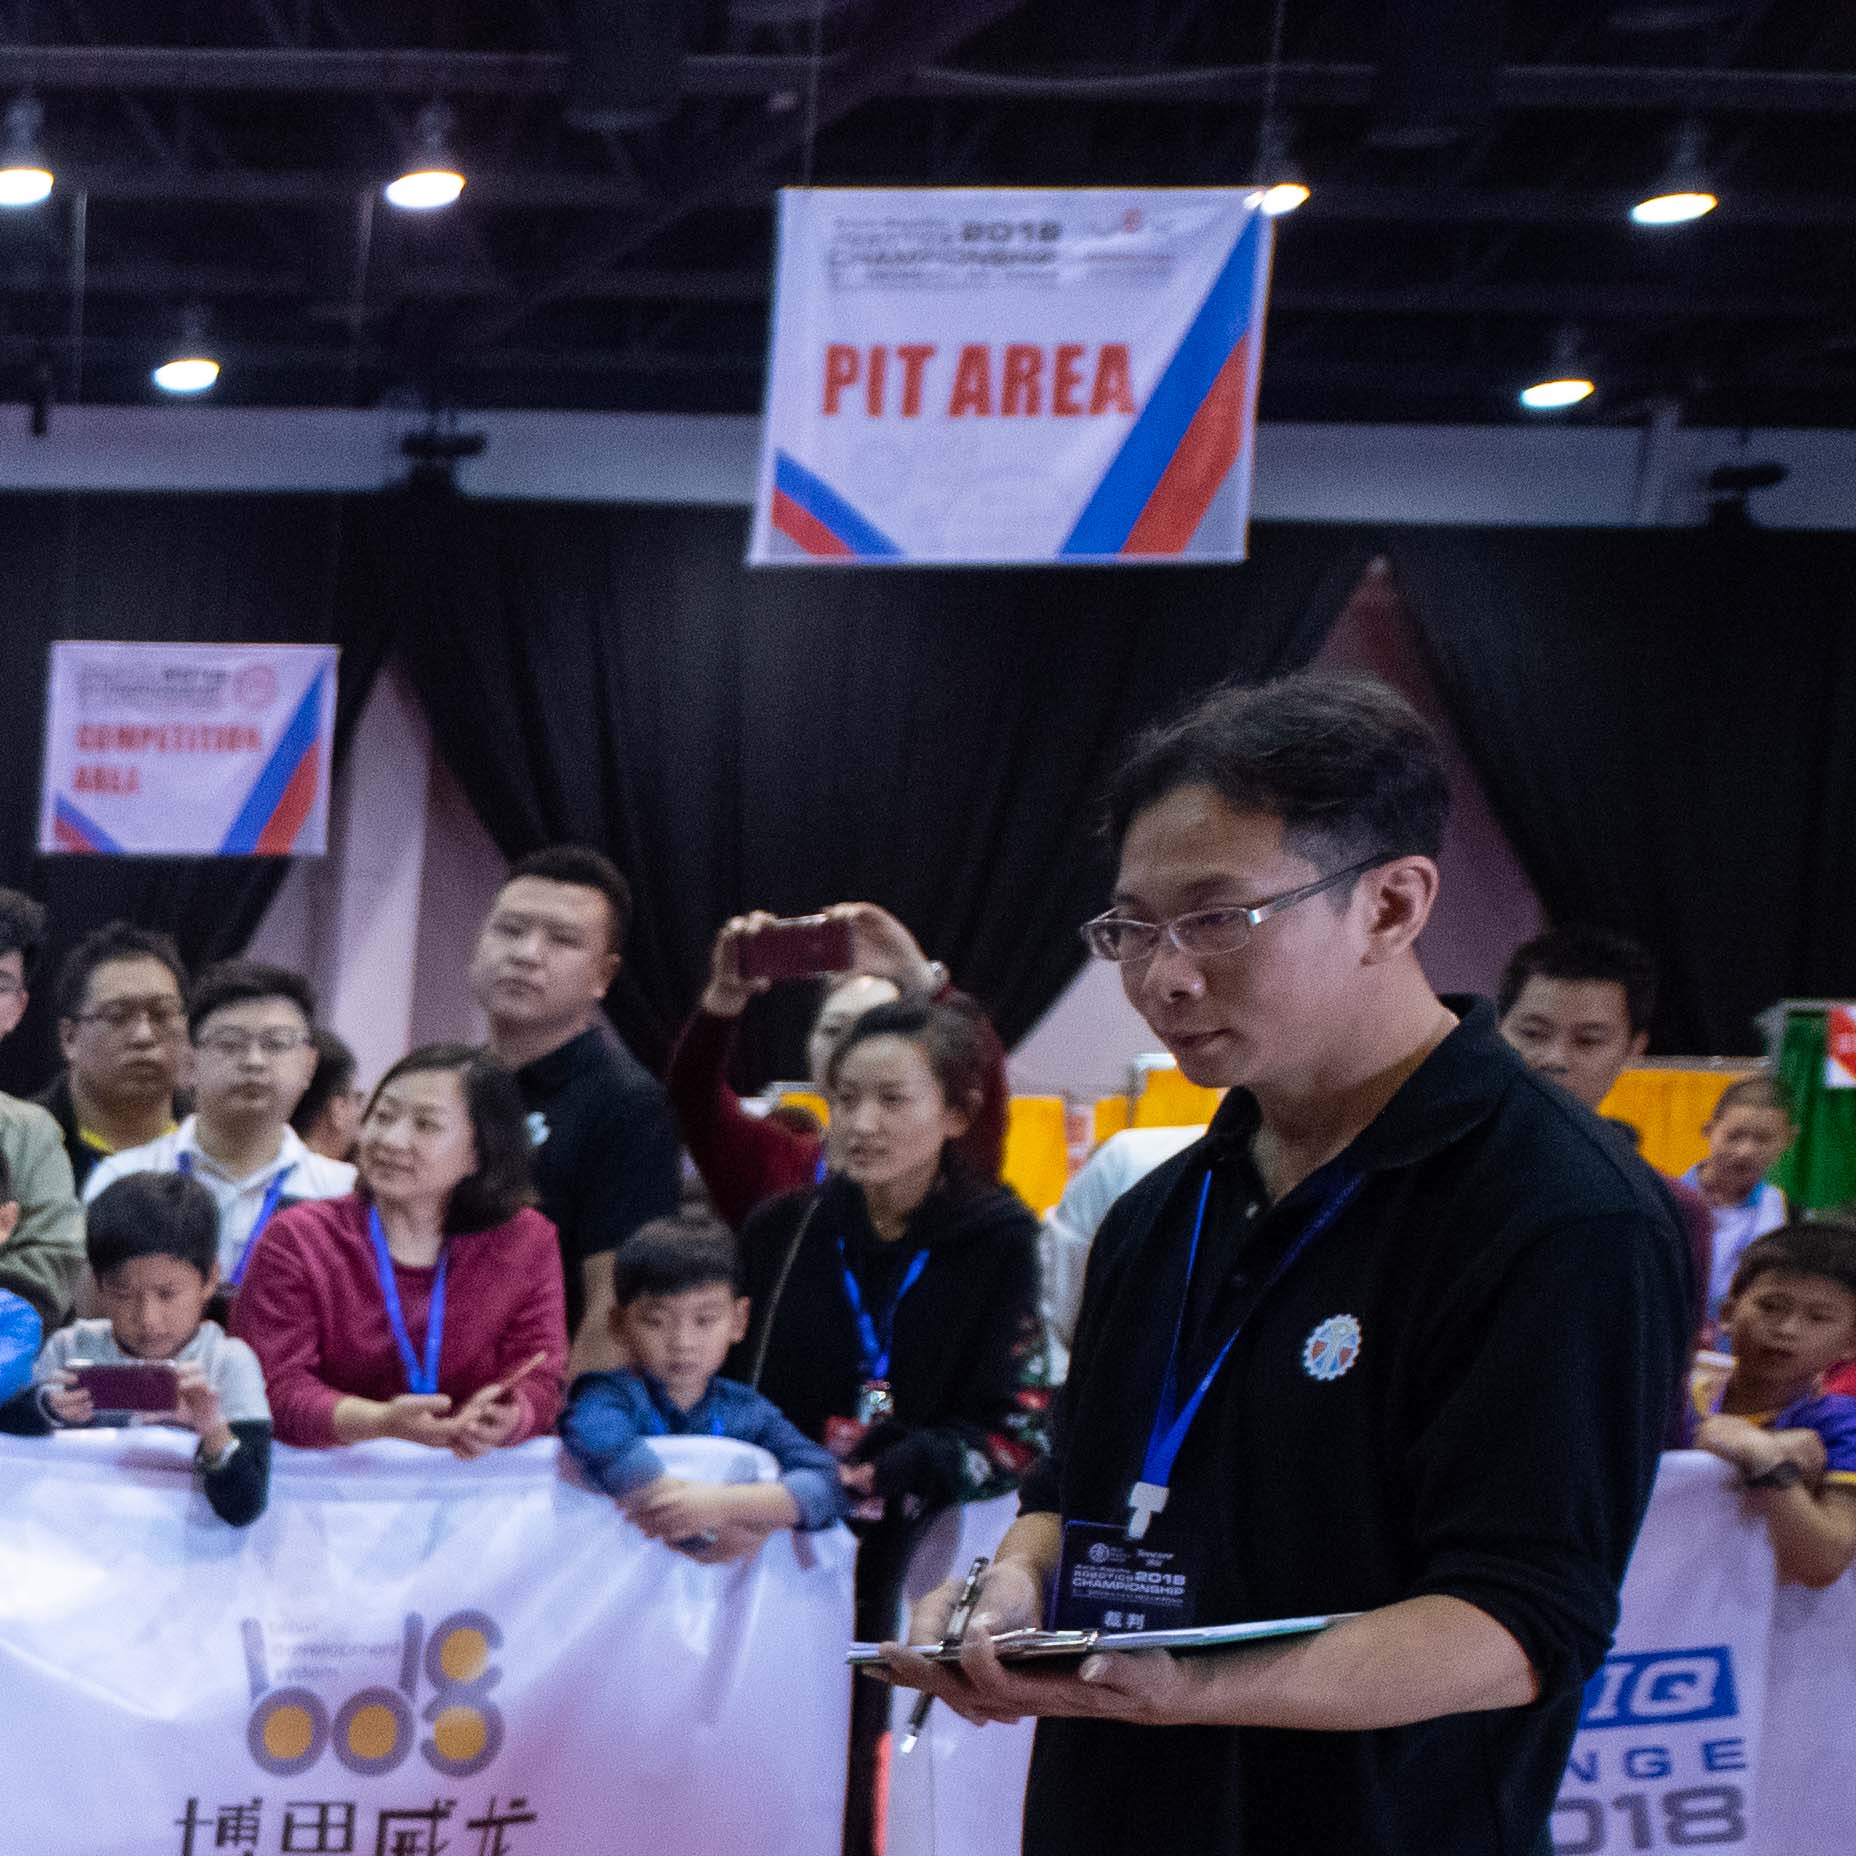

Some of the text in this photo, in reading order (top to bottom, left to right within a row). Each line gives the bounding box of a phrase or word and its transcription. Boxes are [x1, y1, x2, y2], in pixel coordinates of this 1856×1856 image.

[822, 342, 1135, 417] PIT AREA
[1072, 1577, 1186, 1596] CHAMPIONSHIP
[1135, 1571, 1186, 1586] 2018
[1587, 1656, 1723, 1721] IQ
